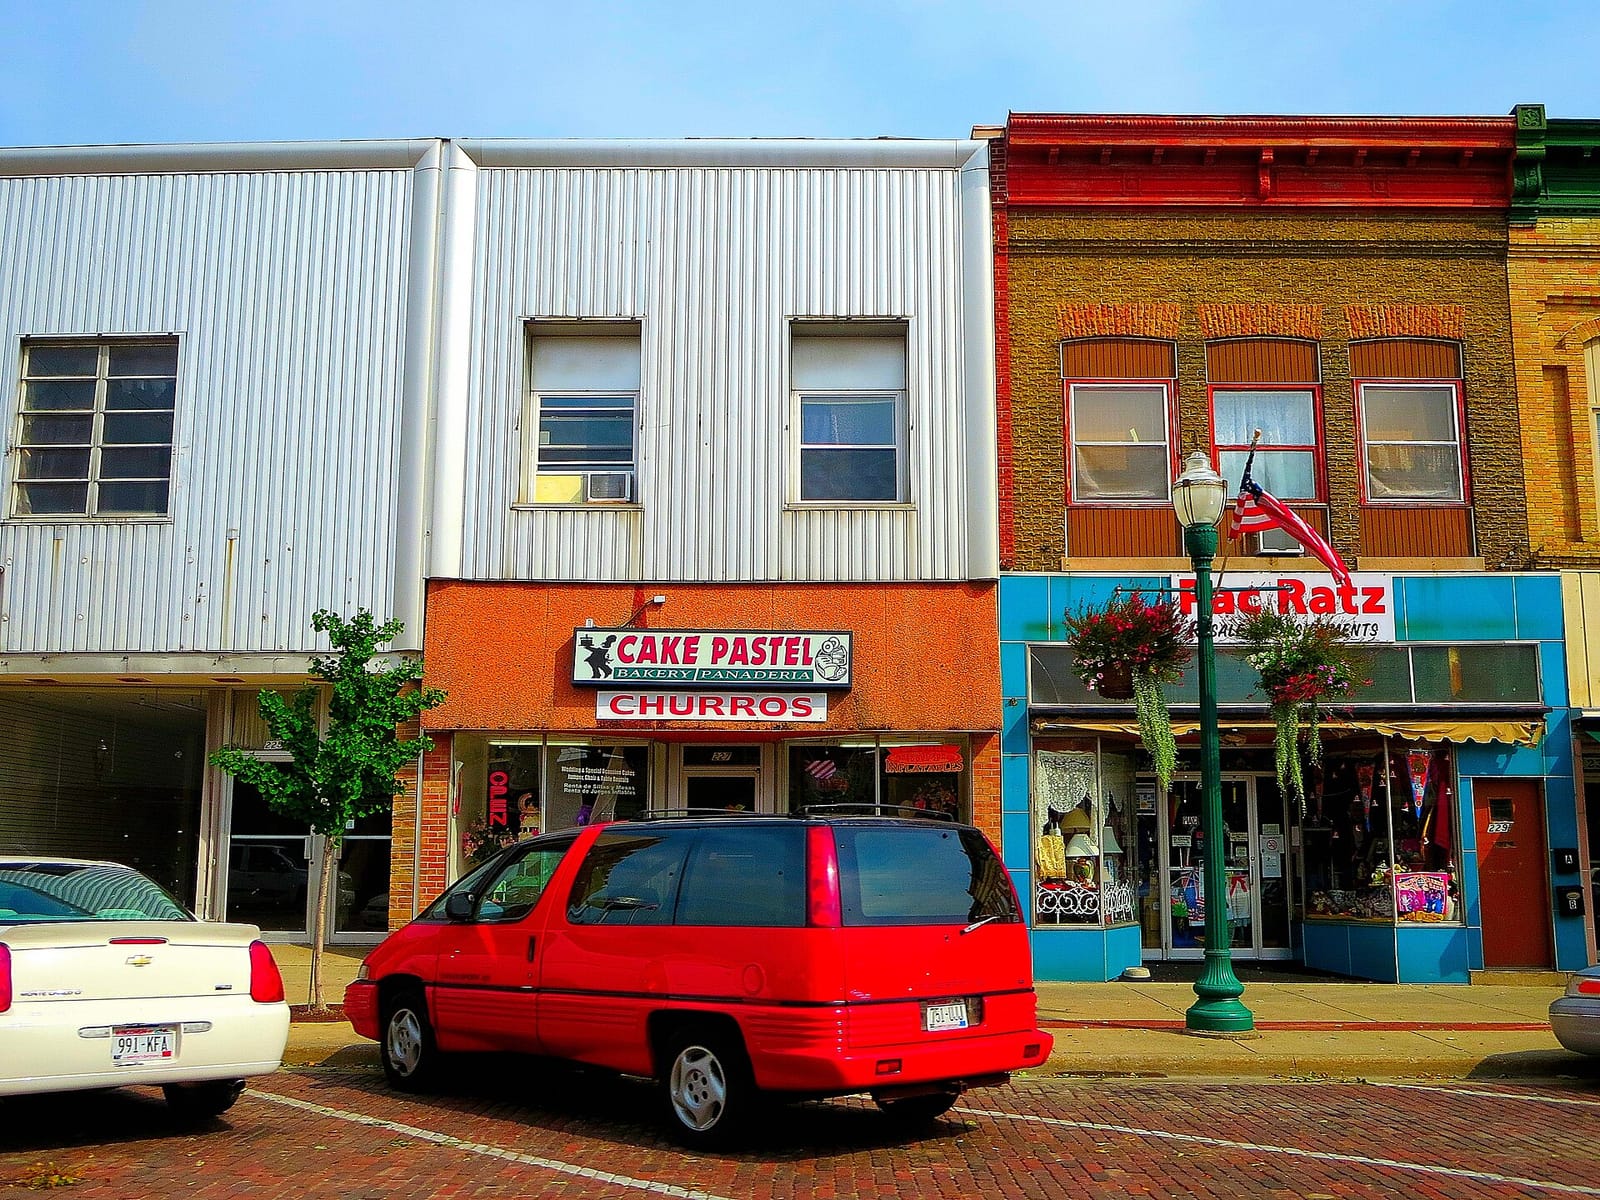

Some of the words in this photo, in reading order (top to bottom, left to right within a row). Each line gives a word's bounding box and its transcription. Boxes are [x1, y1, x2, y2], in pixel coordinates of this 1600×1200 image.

[1277, 579, 1386, 615] Ratz
[617, 635, 700, 665] CAKE
[711, 636, 813, 666] PASTEL
[616, 667, 692, 679] BAKERY
[700, 671, 811, 681] PANADERIA
[609, 694, 813, 718] CHURROS
[490, 771, 508, 826] OPEN
[1488, 824, 1509, 833] 229
[1565, 855, 1573, 864] A
[118, 1036, 168, 1054] 991-KFA
